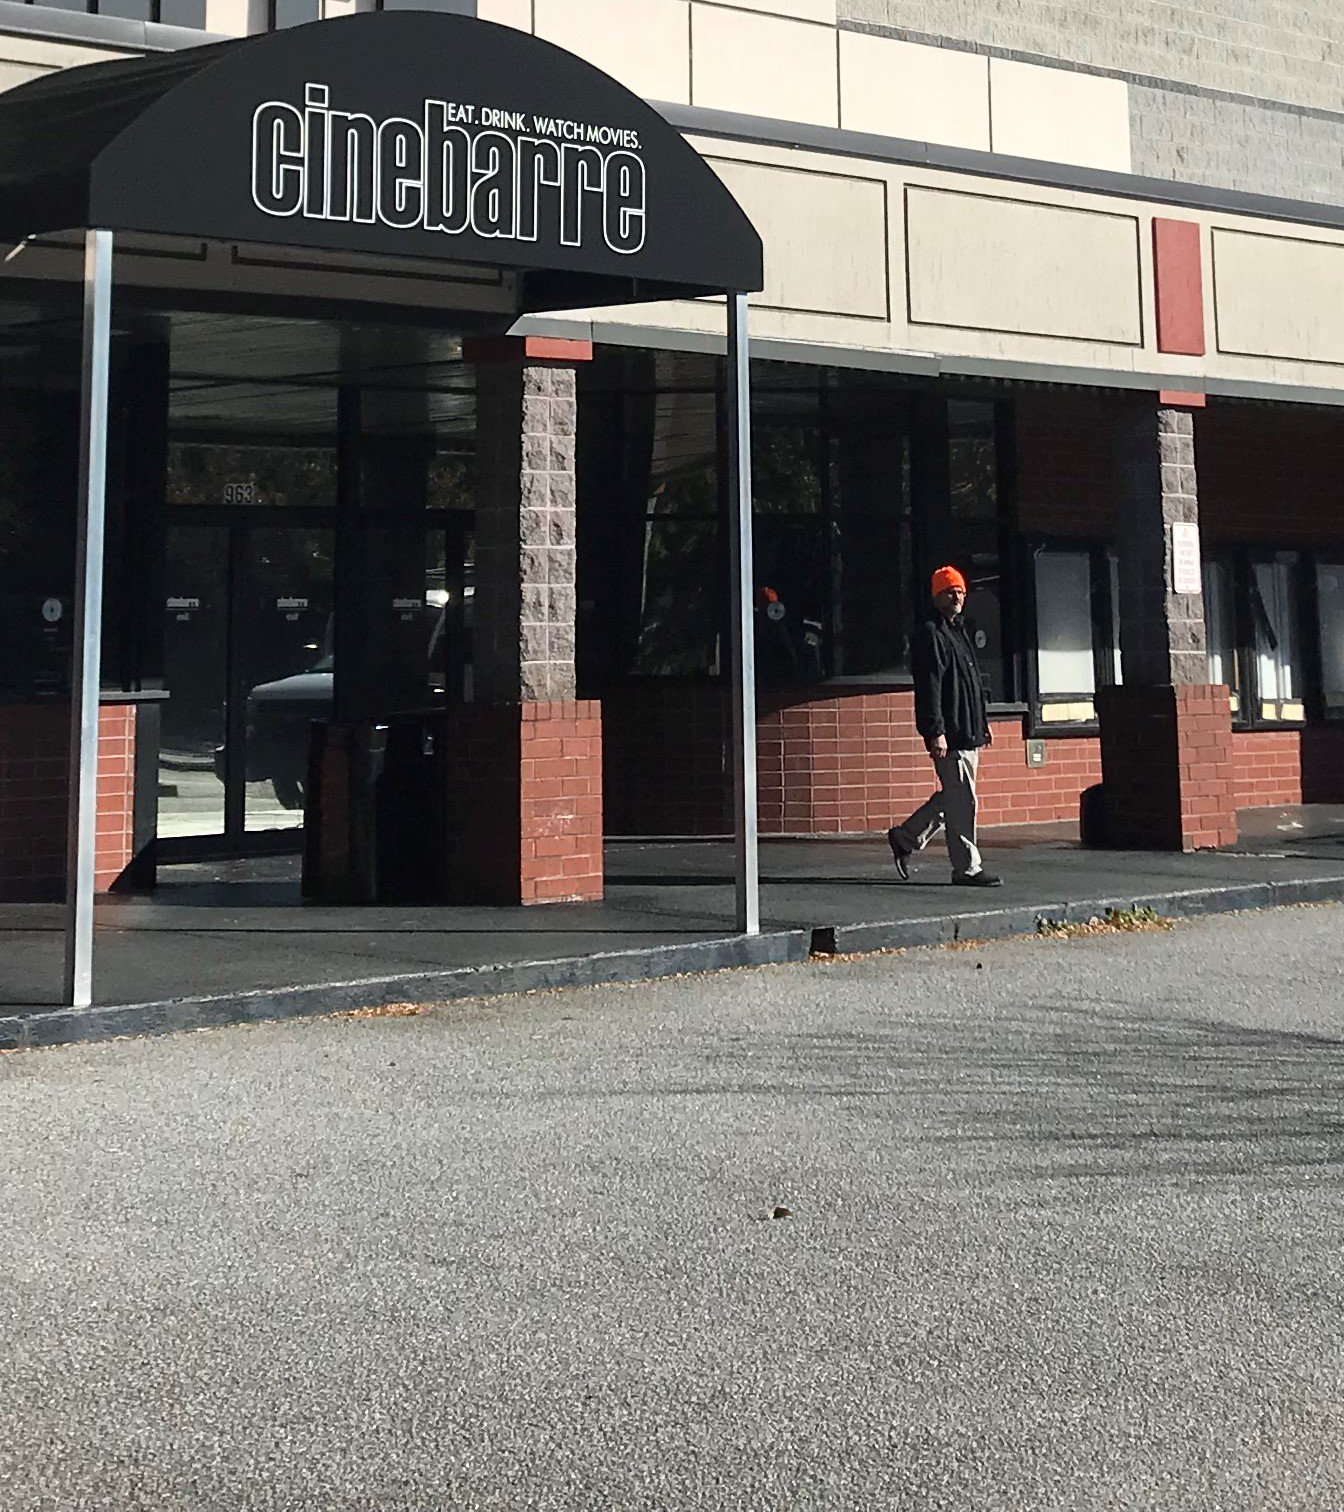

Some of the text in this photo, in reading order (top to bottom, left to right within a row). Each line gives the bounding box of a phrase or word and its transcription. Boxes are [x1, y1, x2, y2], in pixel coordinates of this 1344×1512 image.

[447, 102, 643, 150] EAT. DRINK. WATCH MOVIES.
[251, 82, 647, 255] cinebarre
[225, 483, 254, 504] 963
